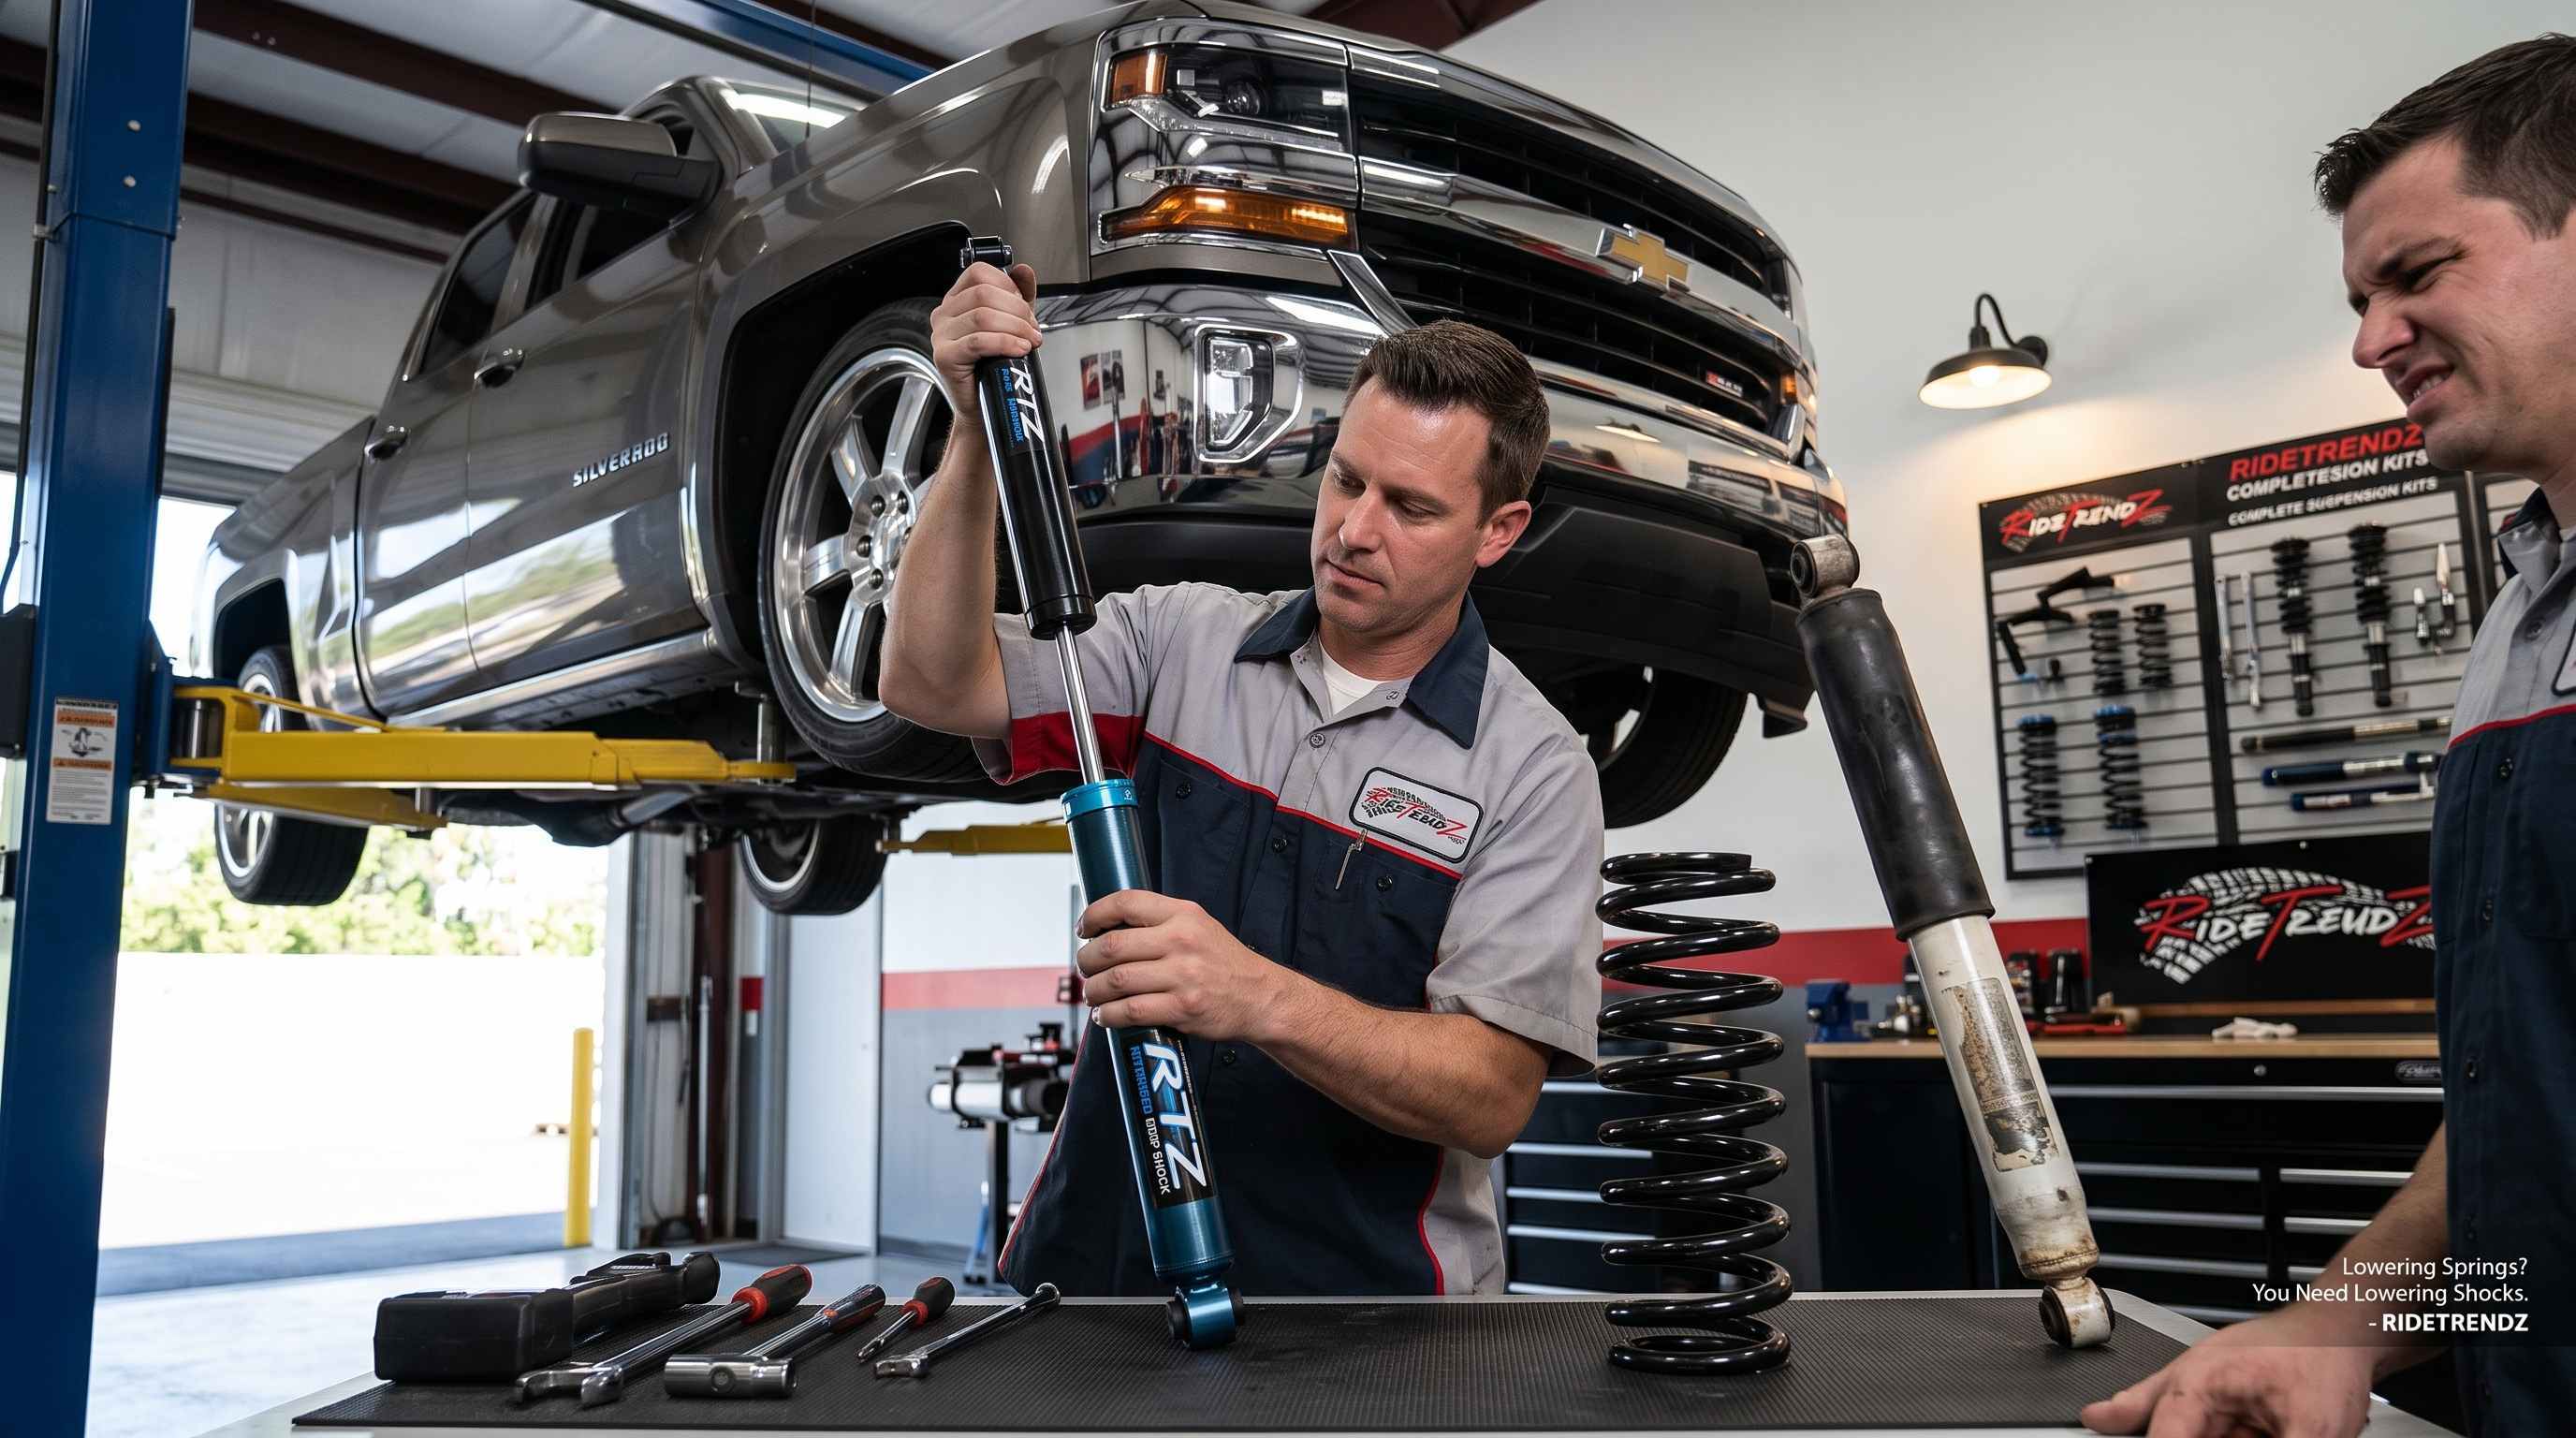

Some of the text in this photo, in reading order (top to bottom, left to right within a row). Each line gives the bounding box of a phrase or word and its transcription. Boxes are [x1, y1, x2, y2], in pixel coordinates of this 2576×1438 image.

[572, 432, 668, 488] SILVERADO
[2381, 448, 2429, 473] KITS
[2401, 476, 2438, 495] KITS
[1143, 1043, 1207, 1189] RTZ
[1152, 1151, 1170, 1195] SHOCK
